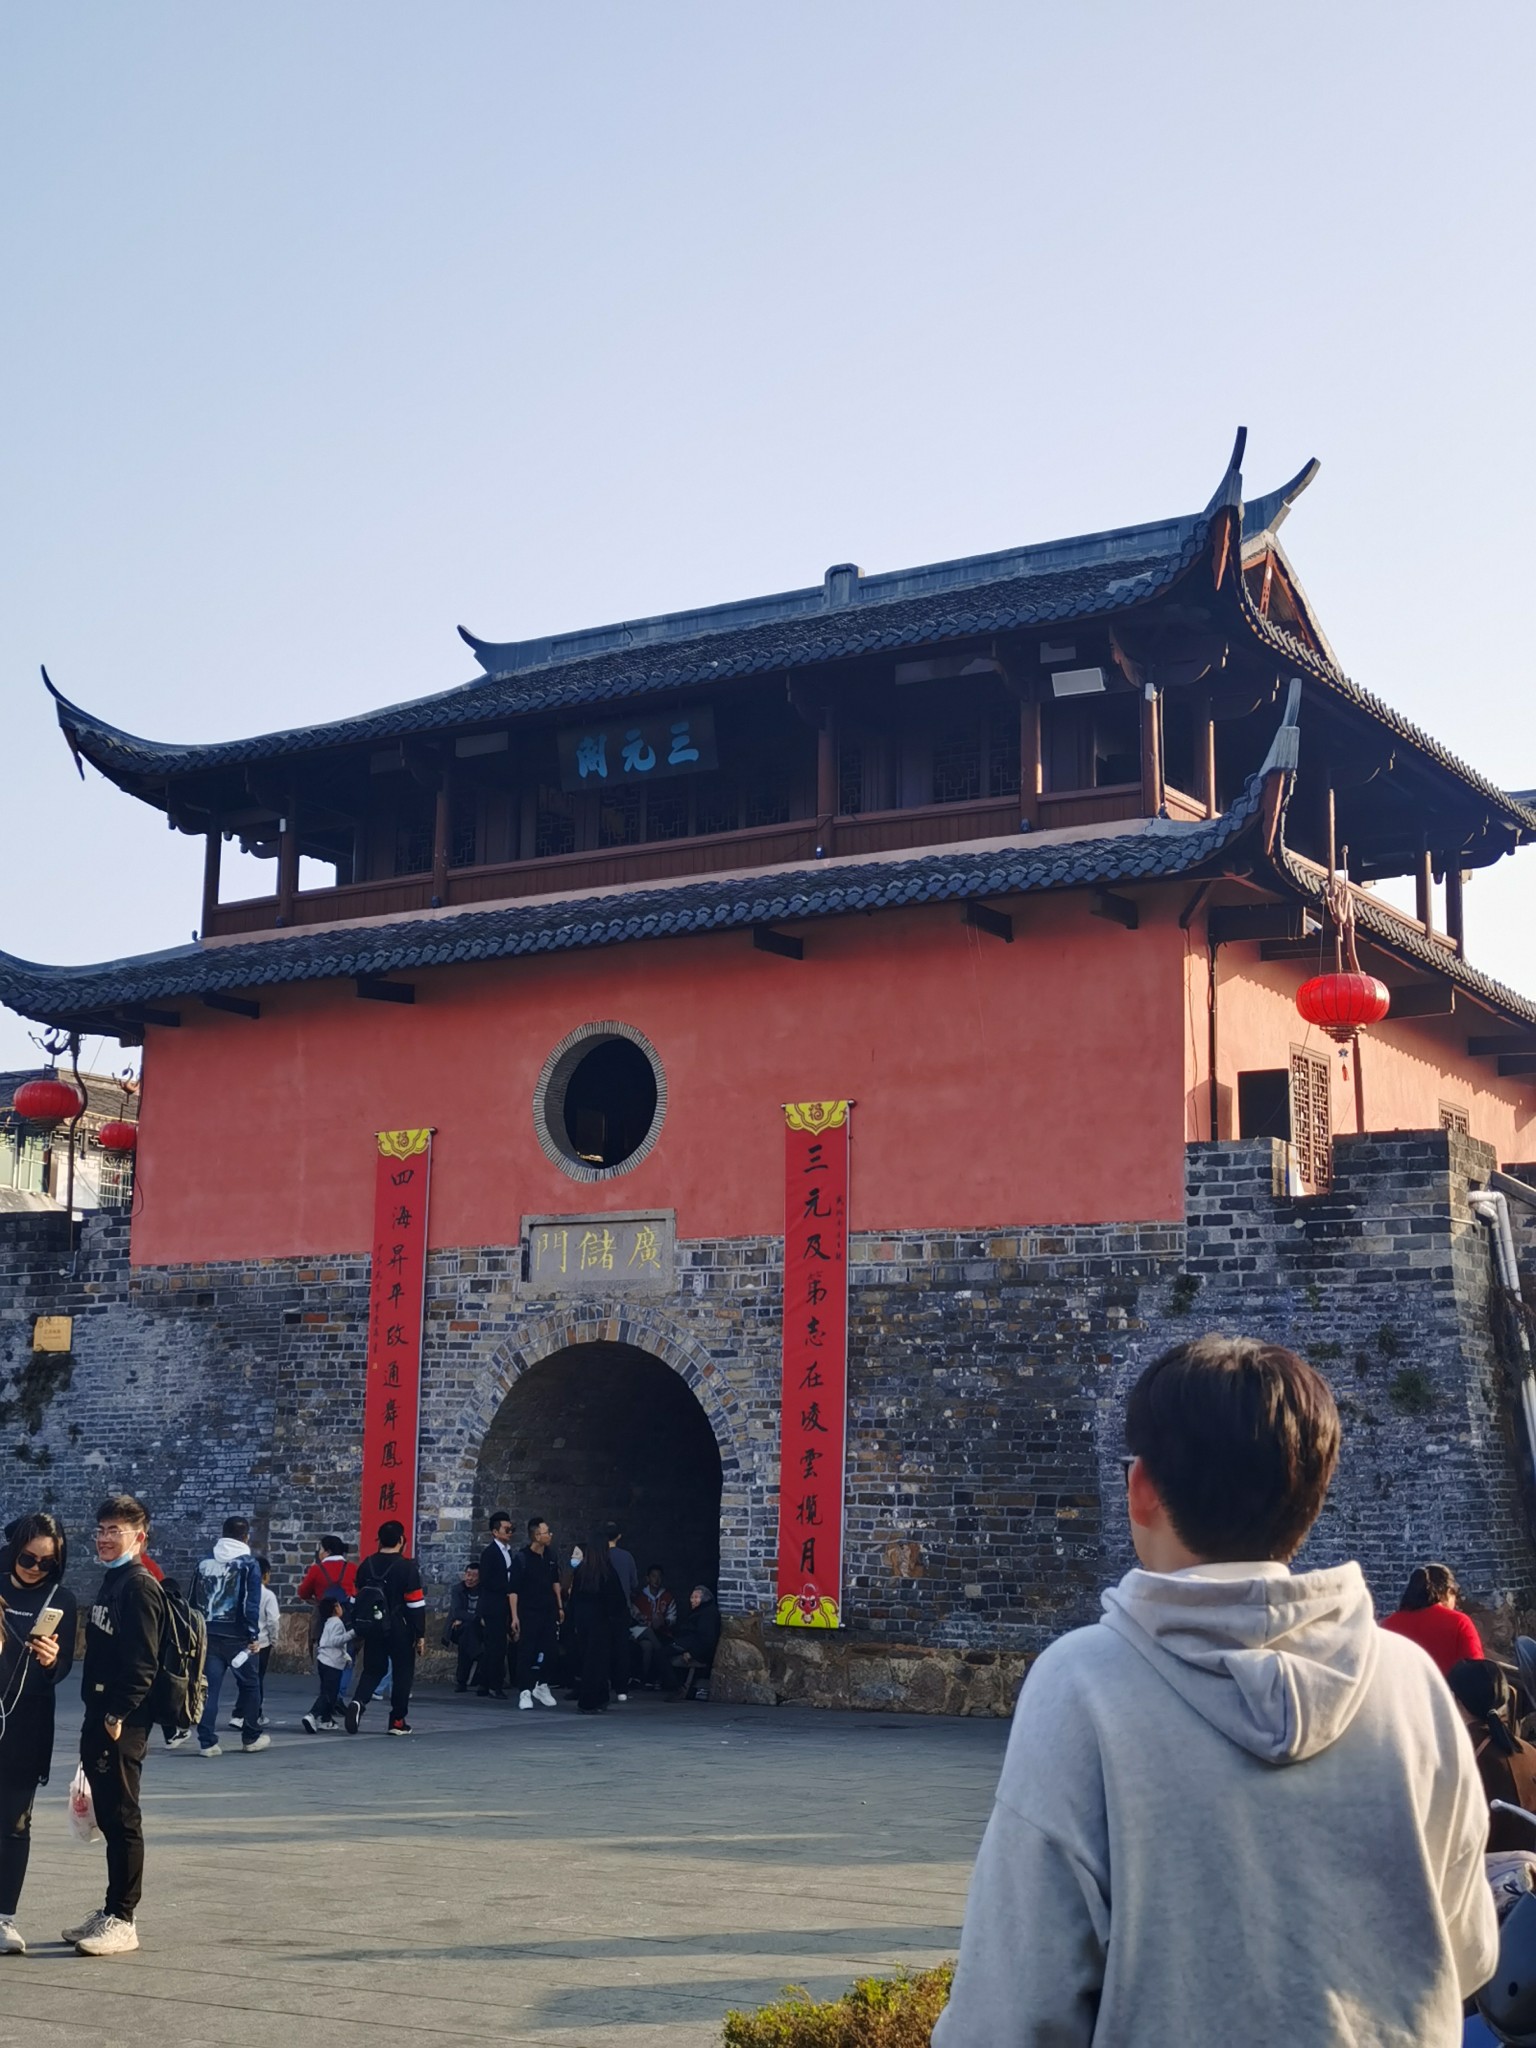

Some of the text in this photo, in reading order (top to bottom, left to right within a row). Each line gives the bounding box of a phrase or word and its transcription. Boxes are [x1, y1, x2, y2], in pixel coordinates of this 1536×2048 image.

[808, 1103, 825, 1121] 福
[396, 1131, 410, 1149] 福
[536, 1225, 663, 1274] 廣儲門
